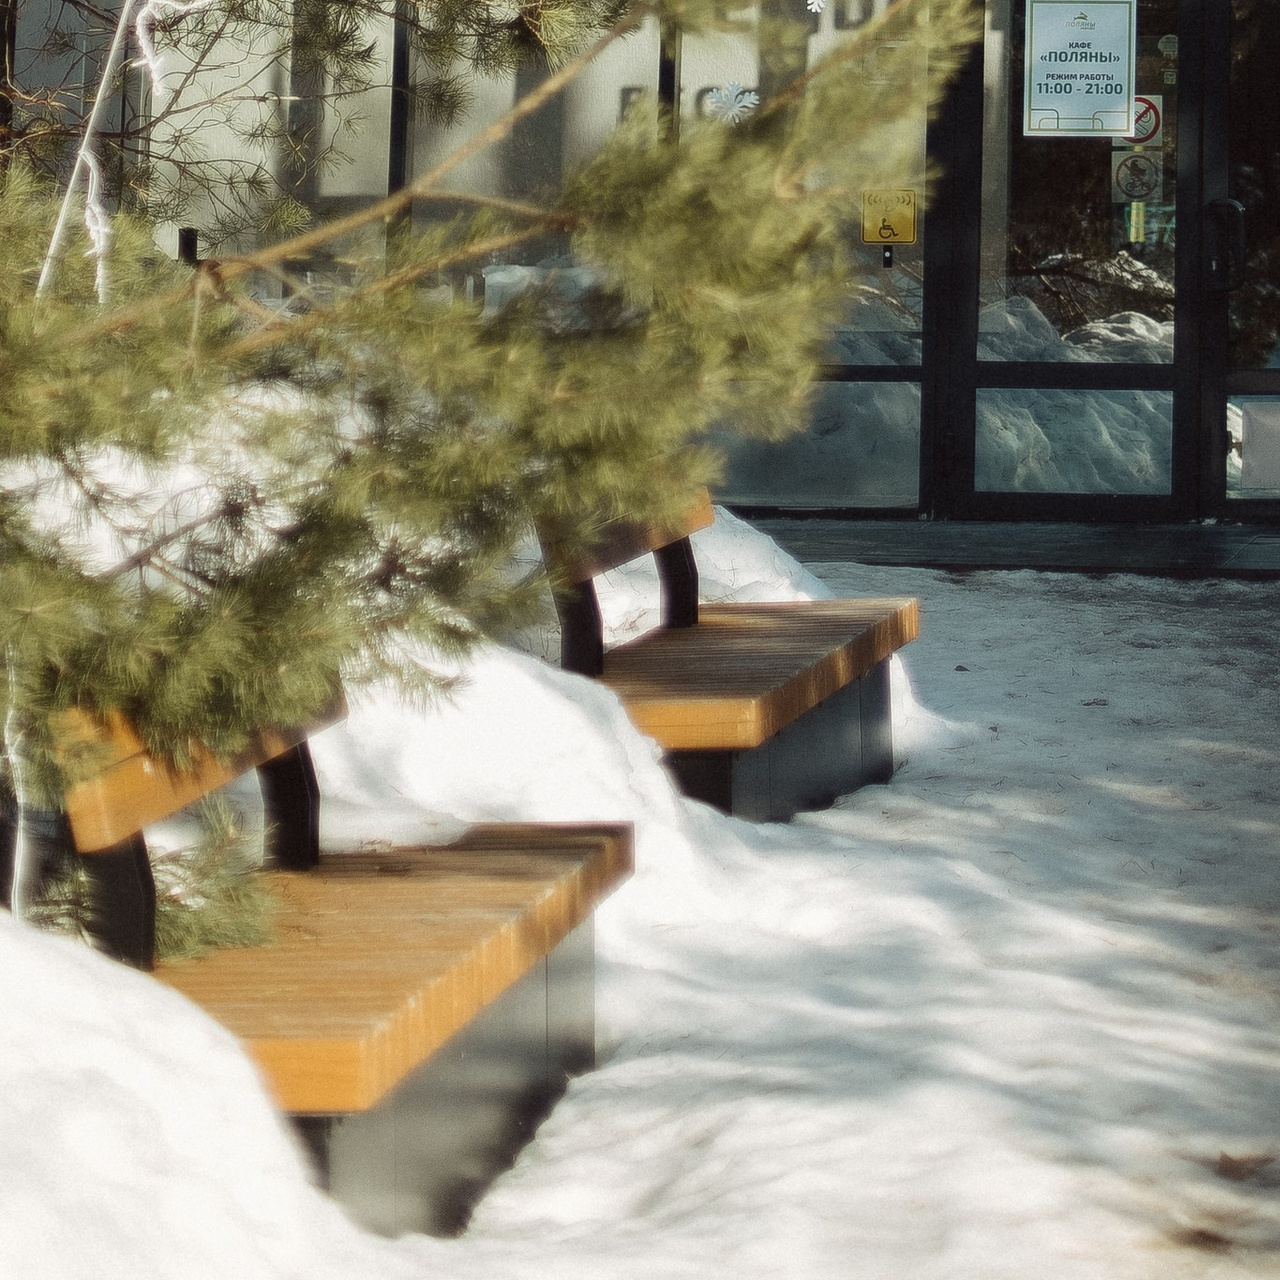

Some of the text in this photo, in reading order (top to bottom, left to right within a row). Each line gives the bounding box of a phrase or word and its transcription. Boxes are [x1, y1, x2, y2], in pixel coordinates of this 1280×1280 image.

[1068, 41, 1092, 49] КАФЕ
[1040, 51, 1120, 63] «ПОЛЯНЫ»
[1045, 73, 1114, 81] РЕЖИМ РАБОТЫ
[1036, 83, 1073, 94] 11:00
[1084, 83, 1123, 95] 21:00
